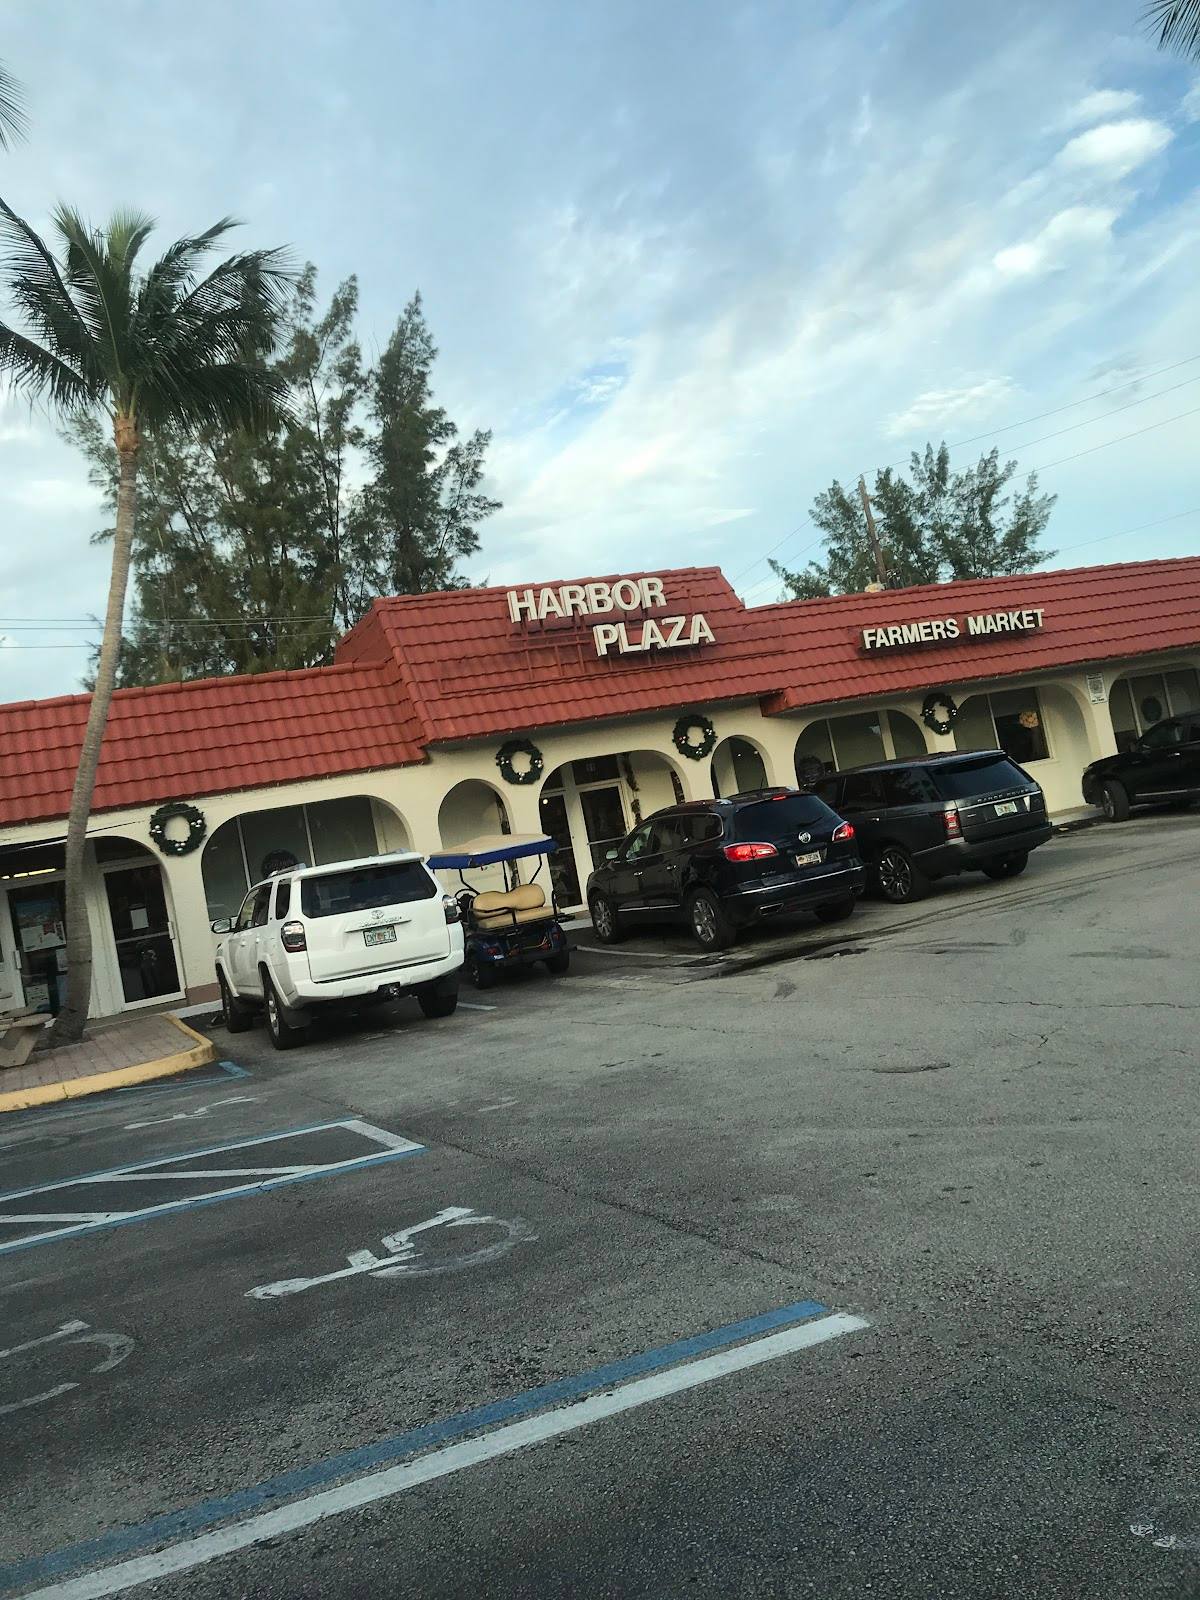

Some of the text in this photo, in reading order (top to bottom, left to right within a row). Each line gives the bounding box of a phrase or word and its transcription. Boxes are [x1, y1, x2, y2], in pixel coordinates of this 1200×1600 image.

[506, 577, 667, 624] HARBOR
[592, 613, 716, 657] PLAZA
[862, 608, 1045, 650] FARMERS MARKET
